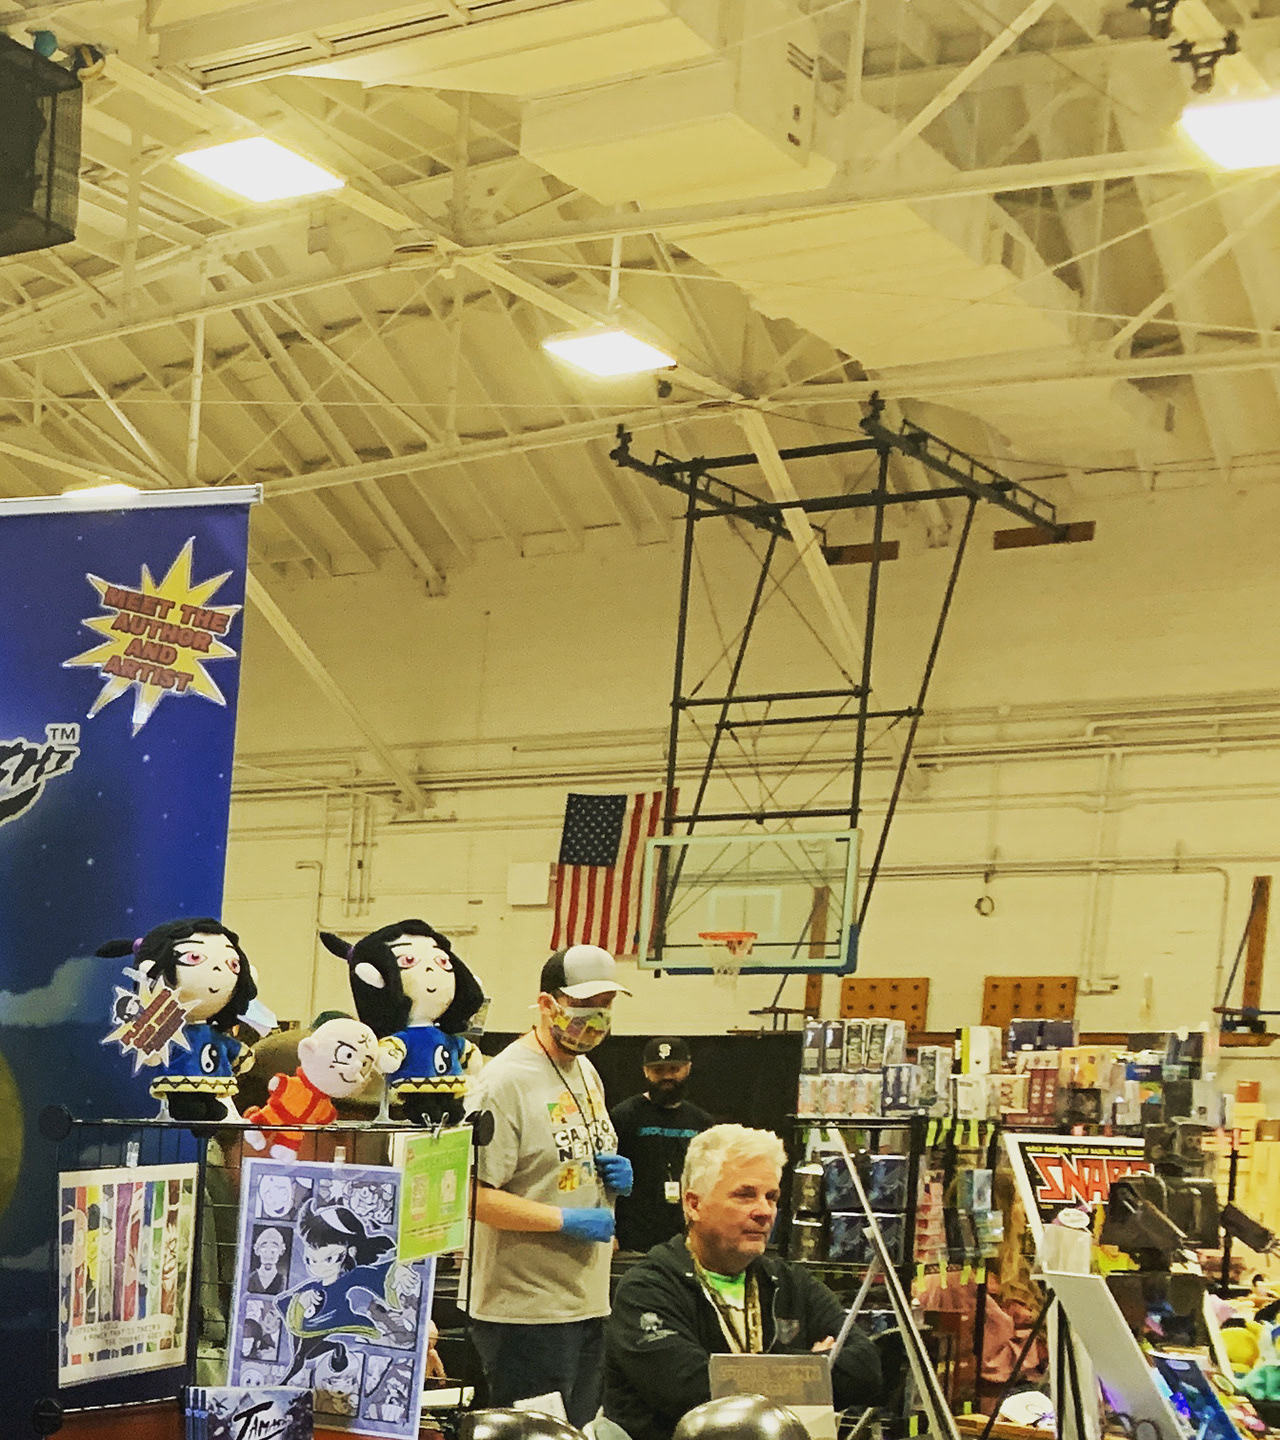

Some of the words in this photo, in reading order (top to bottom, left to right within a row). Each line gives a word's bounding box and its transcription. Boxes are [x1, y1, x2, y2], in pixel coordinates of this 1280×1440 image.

[103, 586, 176, 619] MEET
[180, 604, 230, 633] THE
[111, 612, 213, 653] AUTHOR
[124, 638, 178, 666] AND
[102, 655, 194, 692] ARTIST
